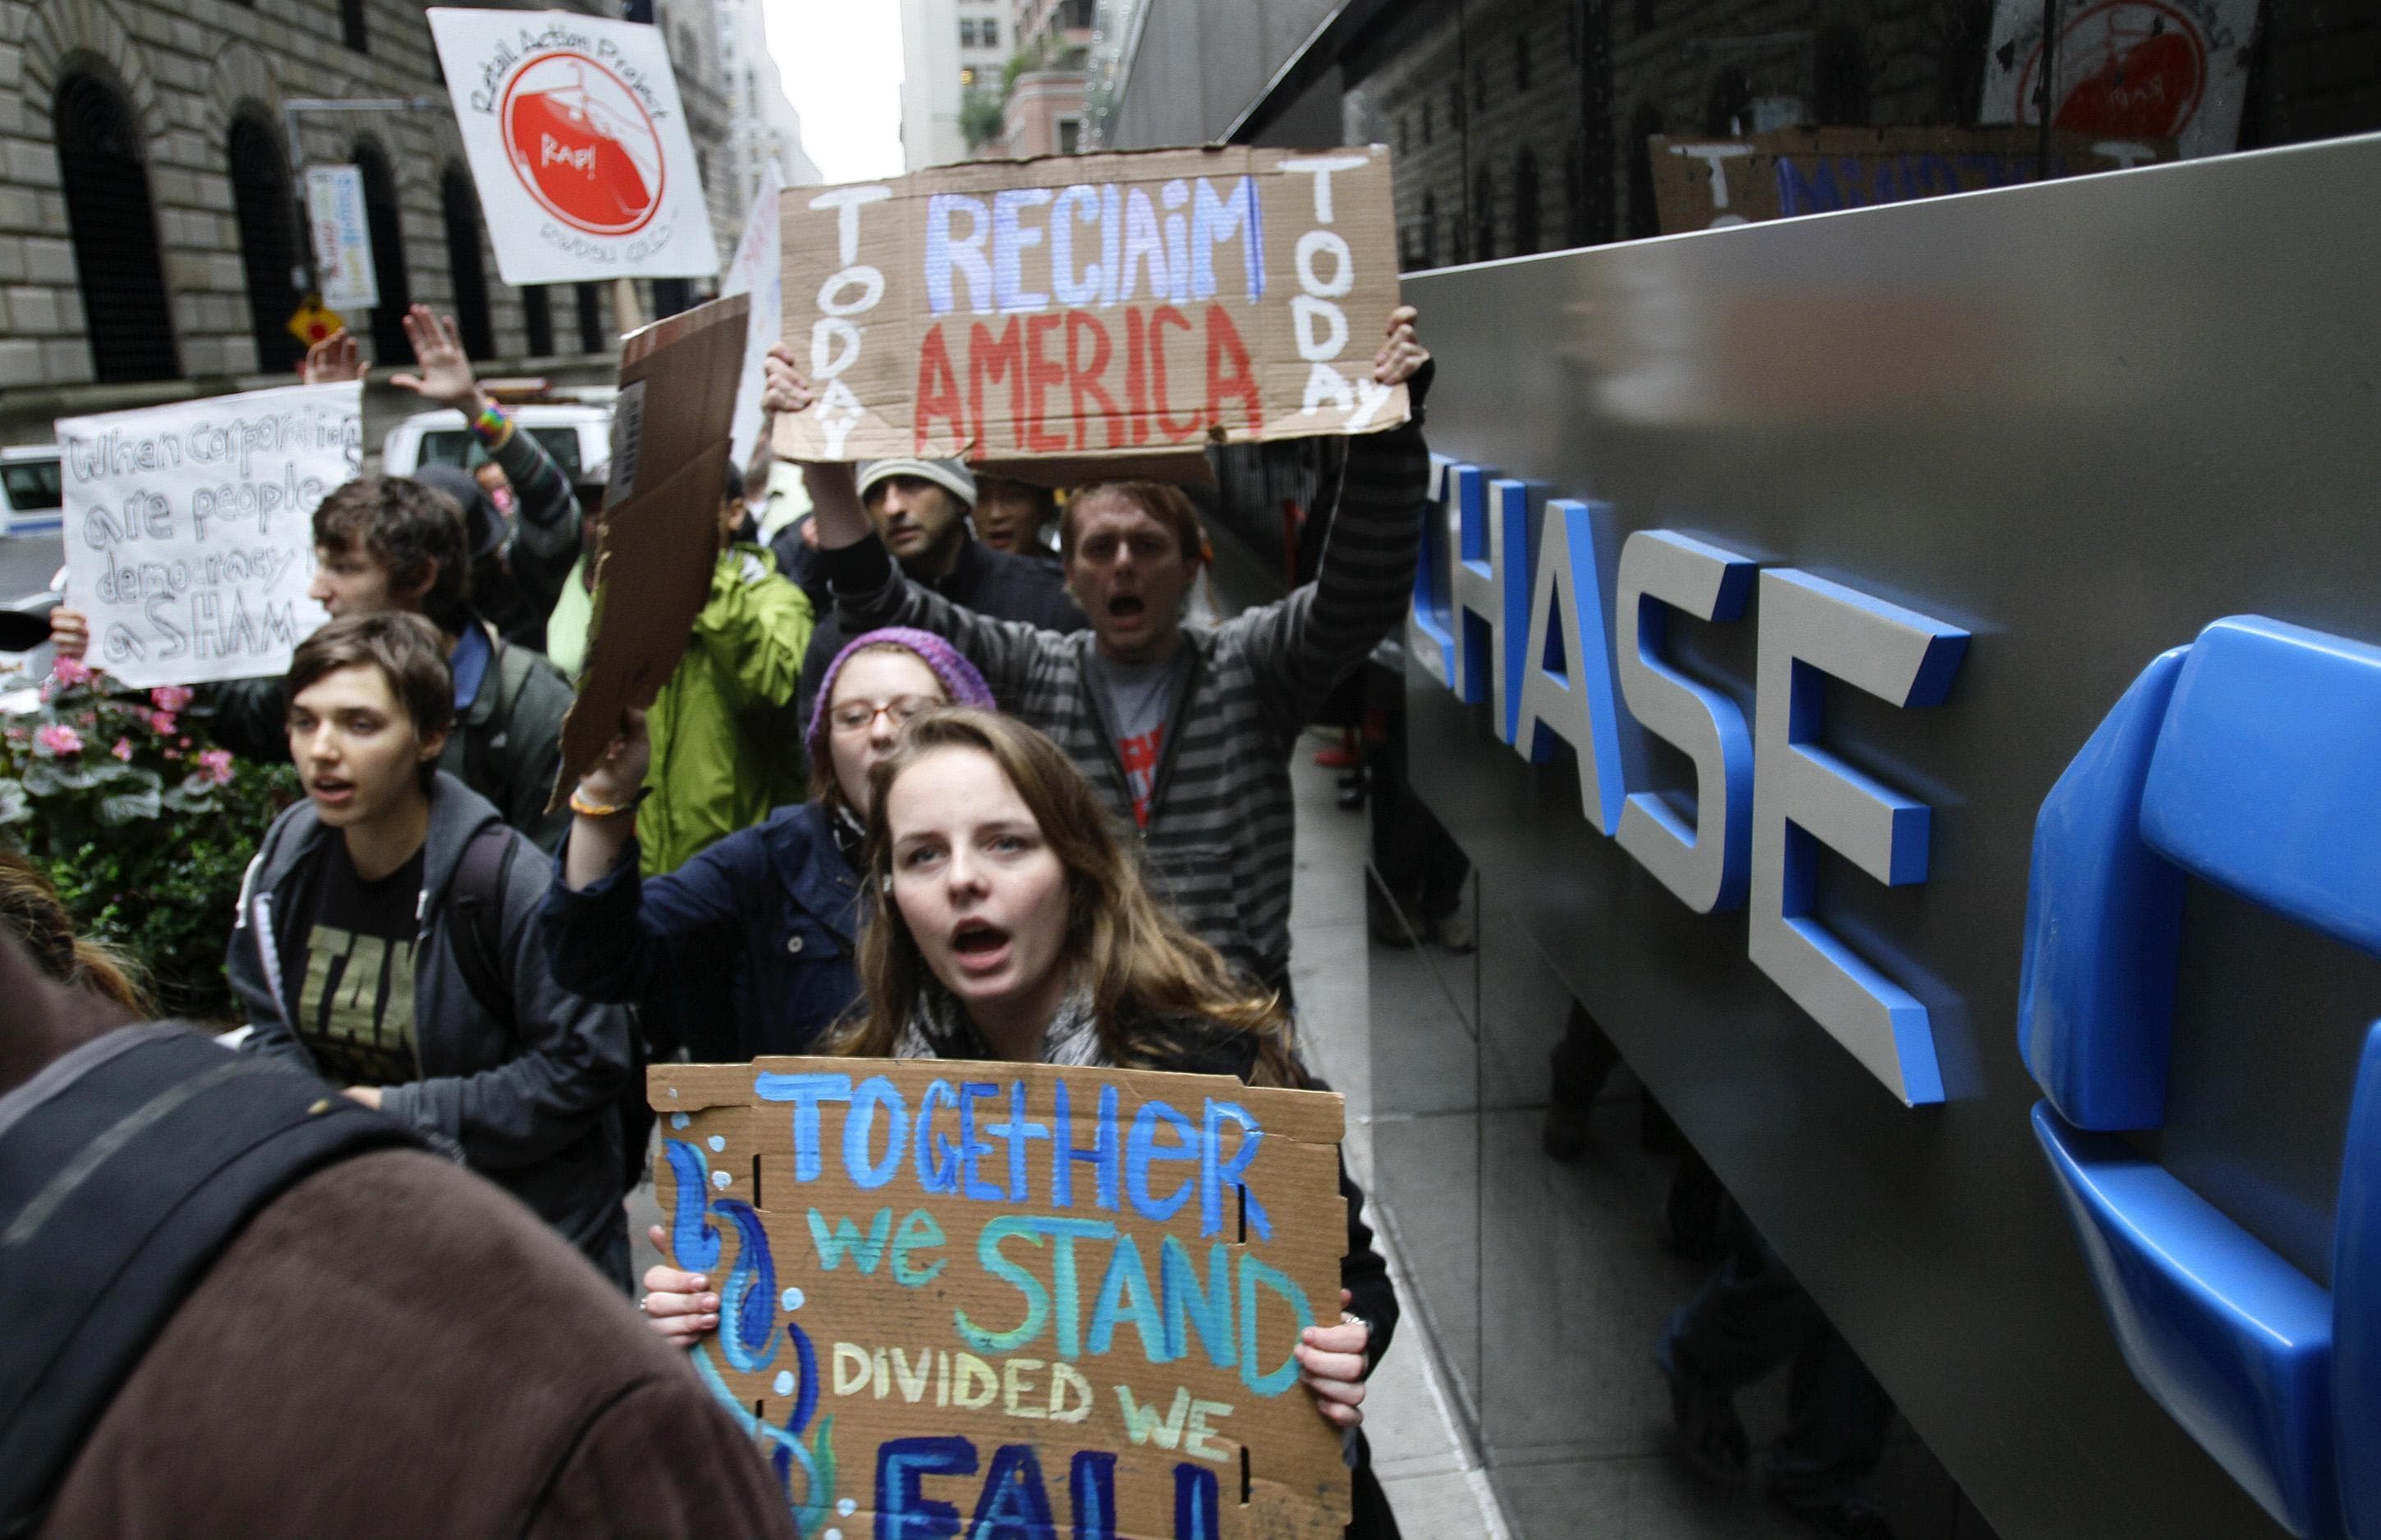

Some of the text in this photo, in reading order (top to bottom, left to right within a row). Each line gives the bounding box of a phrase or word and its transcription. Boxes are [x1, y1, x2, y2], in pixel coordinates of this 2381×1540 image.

[808, 185, 894, 461] TODAY
[915, 300, 1264, 461] AMERICA
[1277, 156, 1393, 433] TODAY
[84, 461, 324, 551] are people
[955, 1216, 1315, 1396] STAND
